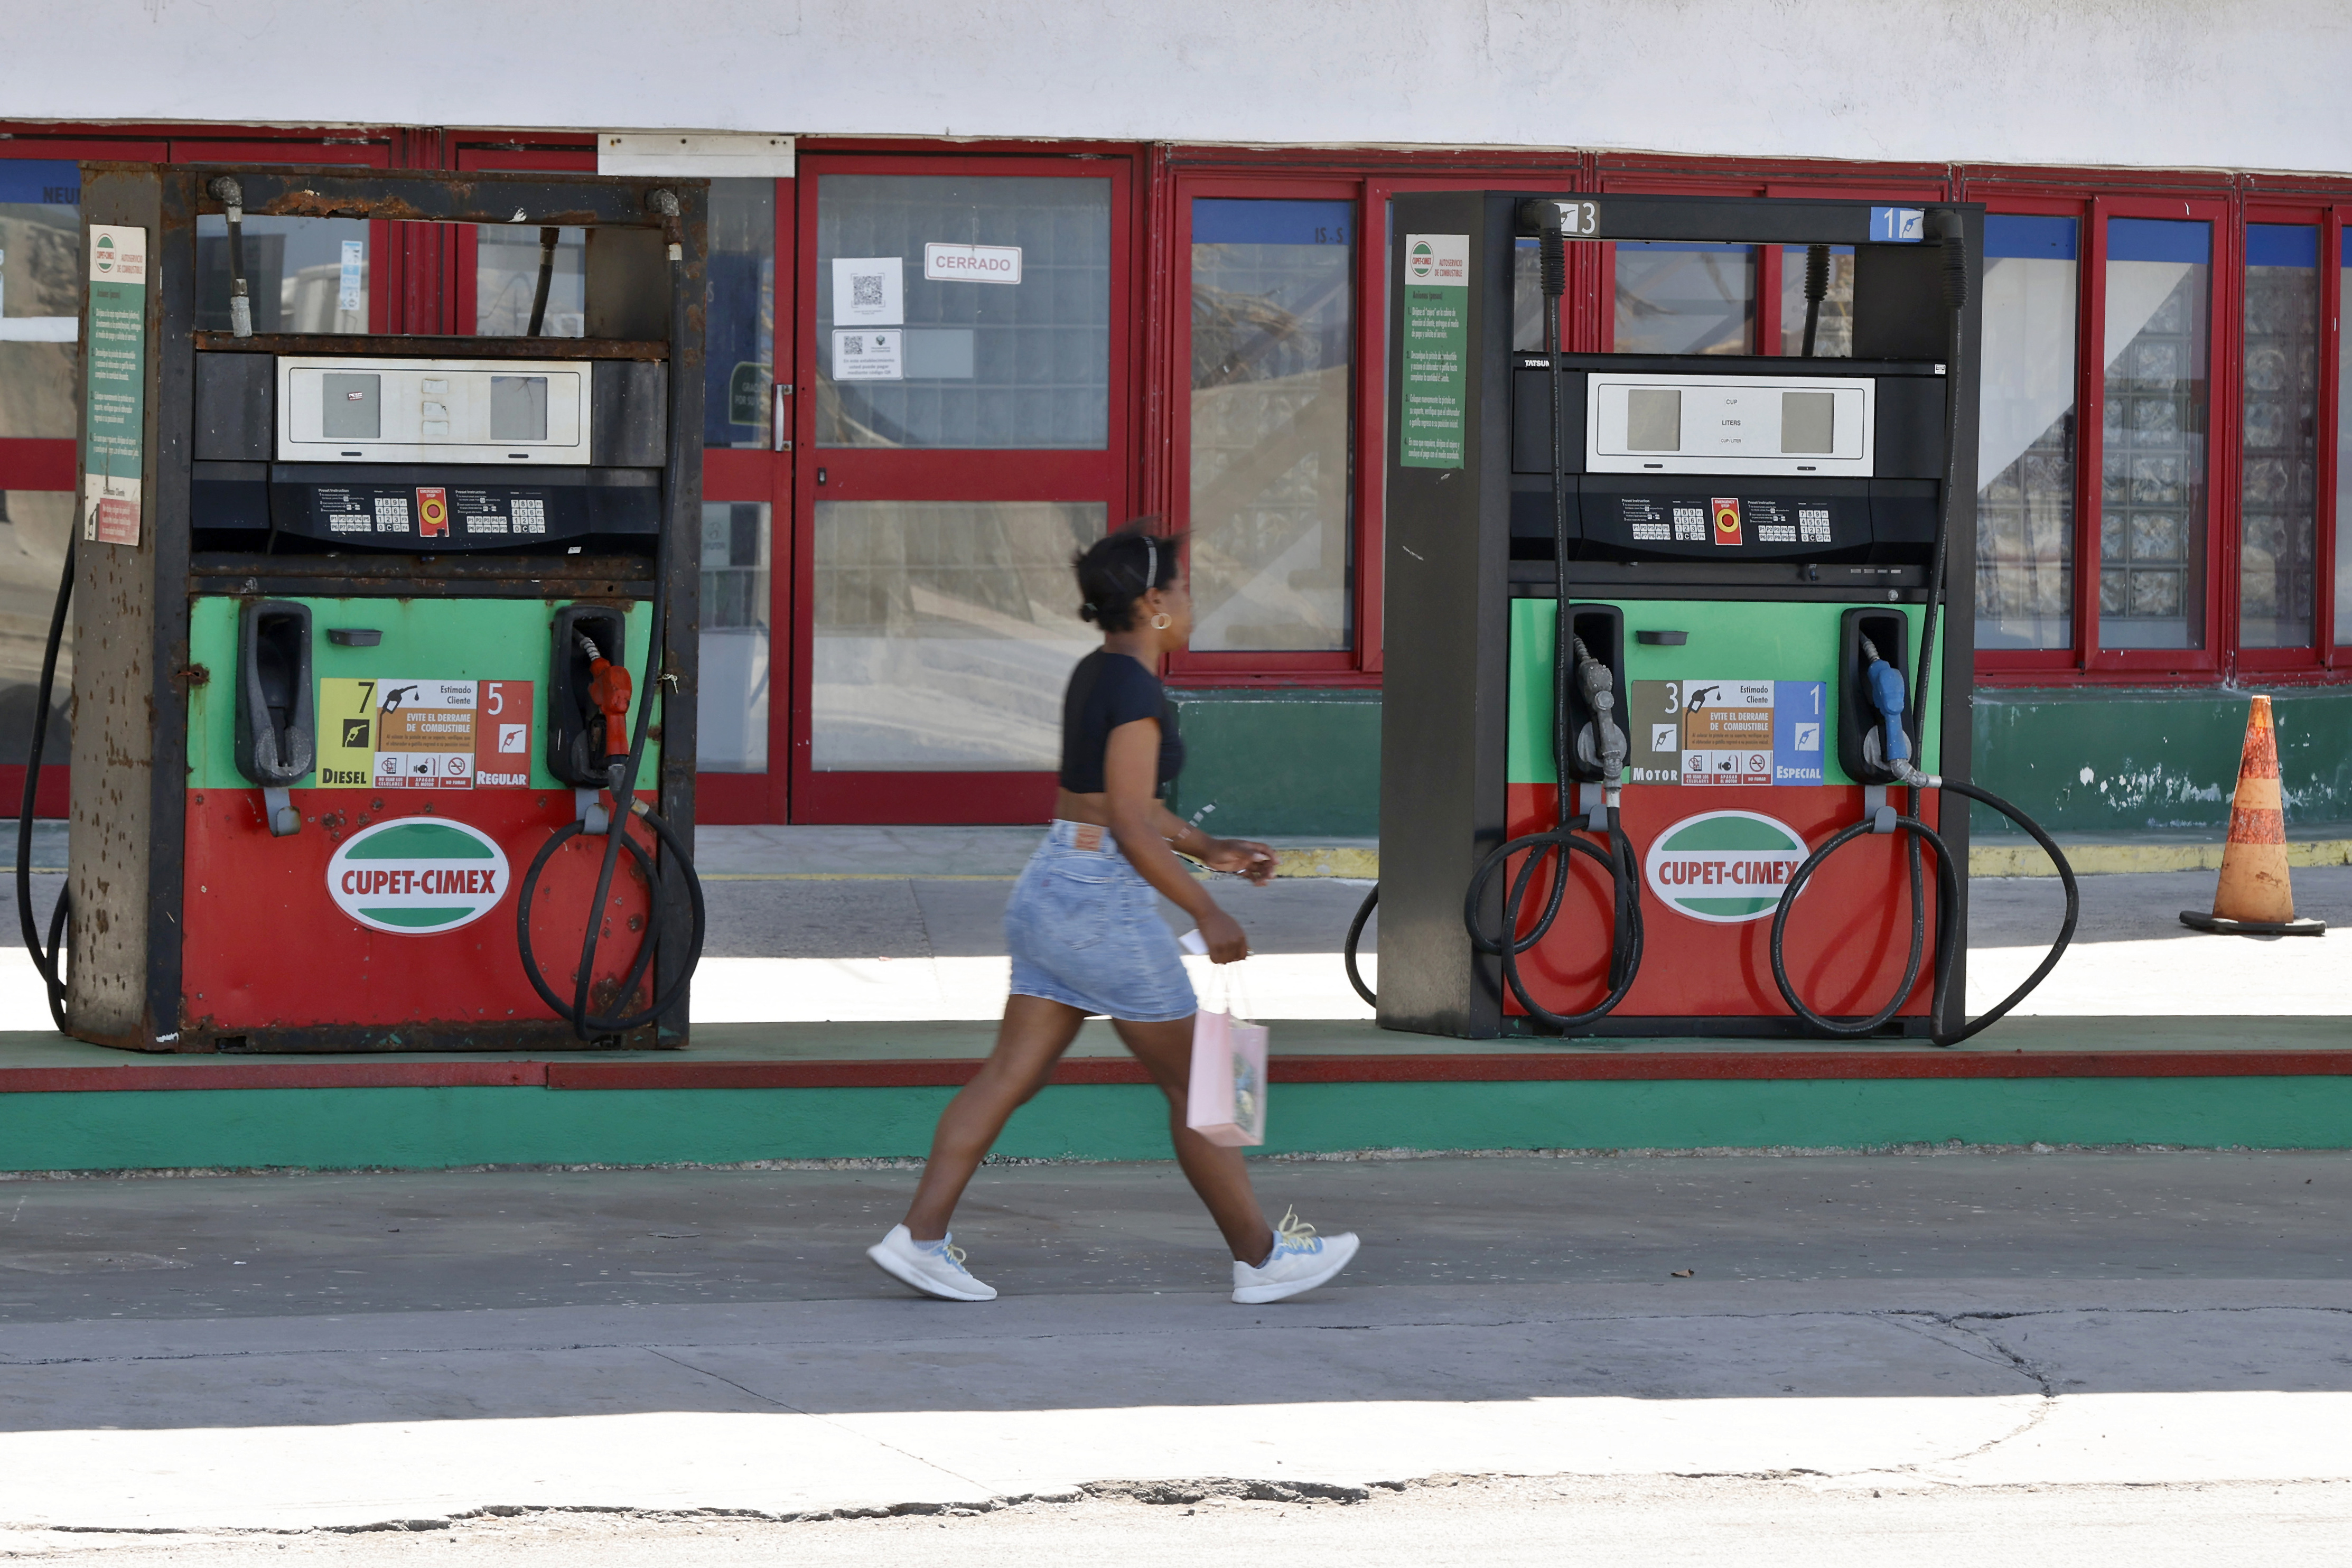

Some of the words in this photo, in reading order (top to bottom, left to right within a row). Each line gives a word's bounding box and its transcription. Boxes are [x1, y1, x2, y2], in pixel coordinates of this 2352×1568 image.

[1582, 202, 1595, 234] 3
[1884, 208, 1893, 238] 1
[936, 256, 1011, 271] CERRADO
[358, 682, 375, 713] 7
[447, 696, 471, 705] Cliente
[488, 683, 503, 715] 5
[1665, 683, 1678, 714] 3
[1810, 684, 1819, 715] 1
[437, 714, 471, 722] DERRAME
[1730, 712, 1737, 721] EL
[406, 723, 416, 732] DE
[421, 724, 470, 732] COMBUSTIBLE
[323, 768, 367, 784] DIESEL
[477, 771, 526, 785] REGULAR
[1633, 768, 1678, 781] MOTOR
[1777, 766, 1821, 779] ESPECIAL
[1659, 861, 1799, 885] CUPET-CIMEX
[341, 870, 496, 895] CUPET-CIMEX
